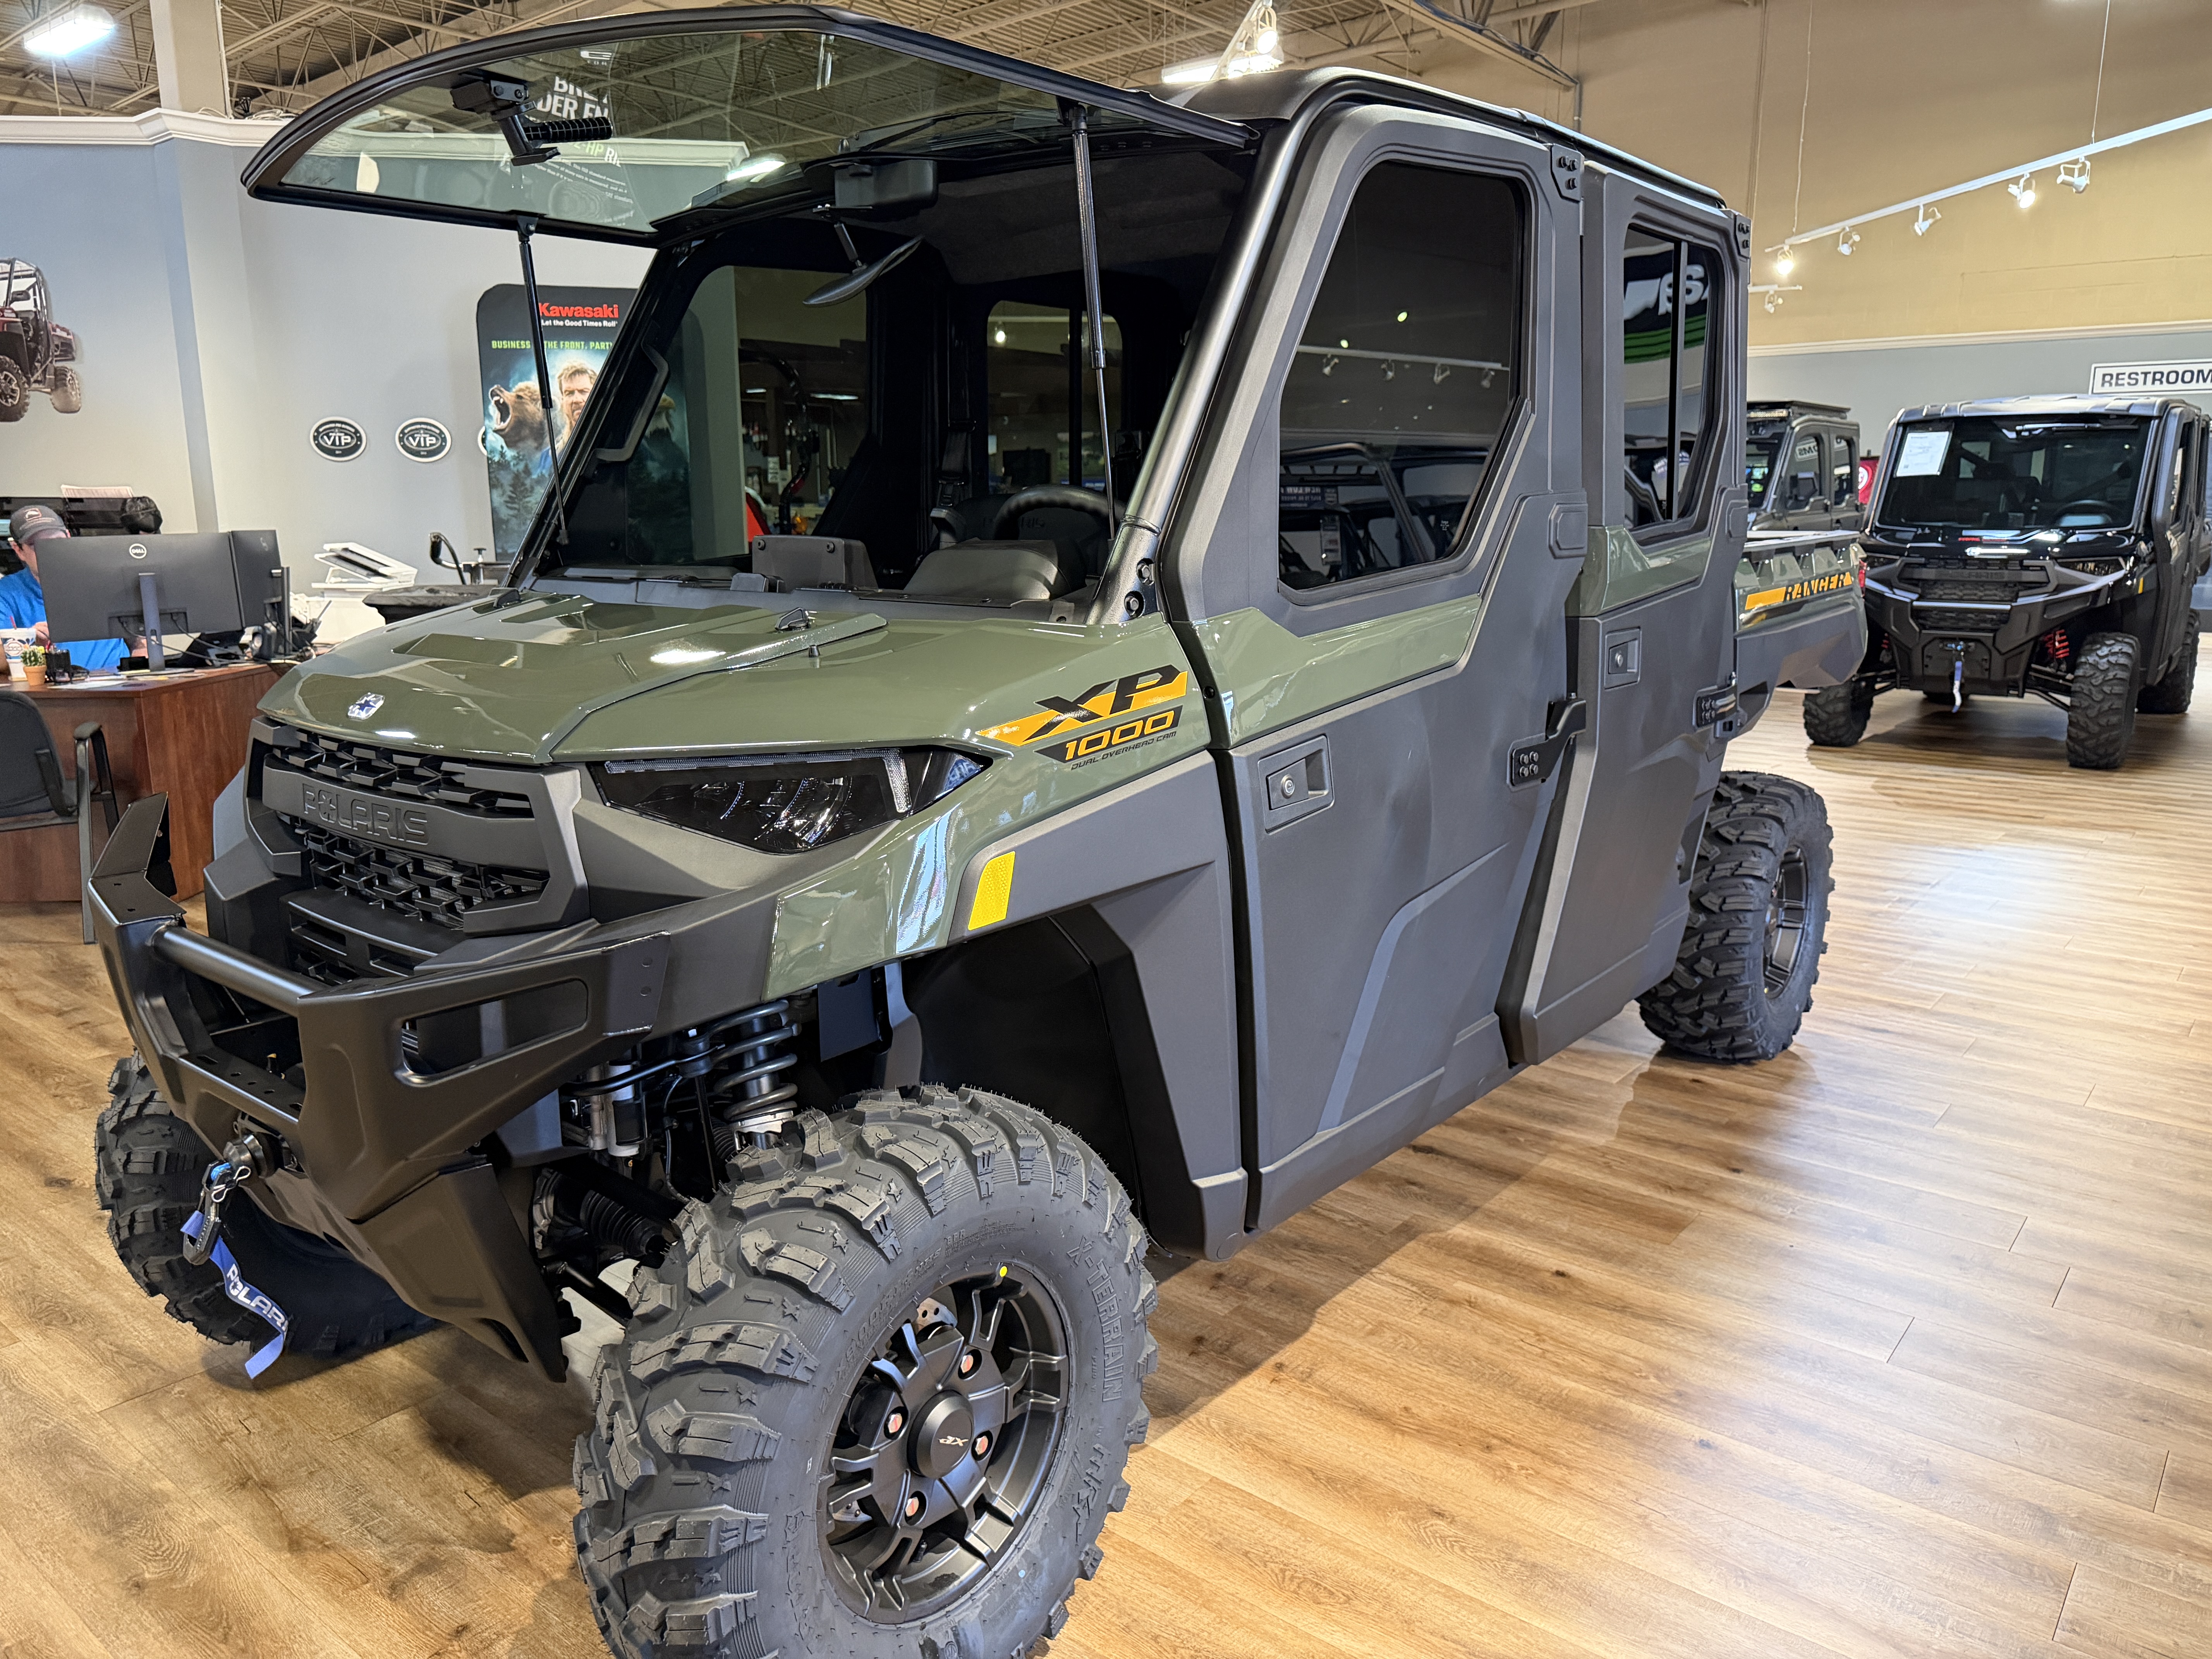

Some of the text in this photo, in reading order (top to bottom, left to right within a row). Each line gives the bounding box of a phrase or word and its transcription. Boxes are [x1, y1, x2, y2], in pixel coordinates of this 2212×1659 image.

[539, 302, 619, 318] Kawasaki
[491, 340, 531, 349] BUSINESS
[544, 340, 558, 349] THE
[323, 435, 351, 446] VIP
[409, 436, 436, 447] VIP
[1783, 573, 1847, 601] RANGER
[1022, 664, 1181, 742] XP
[1065, 710, 1175, 761] 1000
[1071, 731, 1176, 770] DUAL OVERHEAD CAM
[302, 783, 428, 845] POLARIS
[1066, 1235, 1124, 1402] X-TERRAIN
